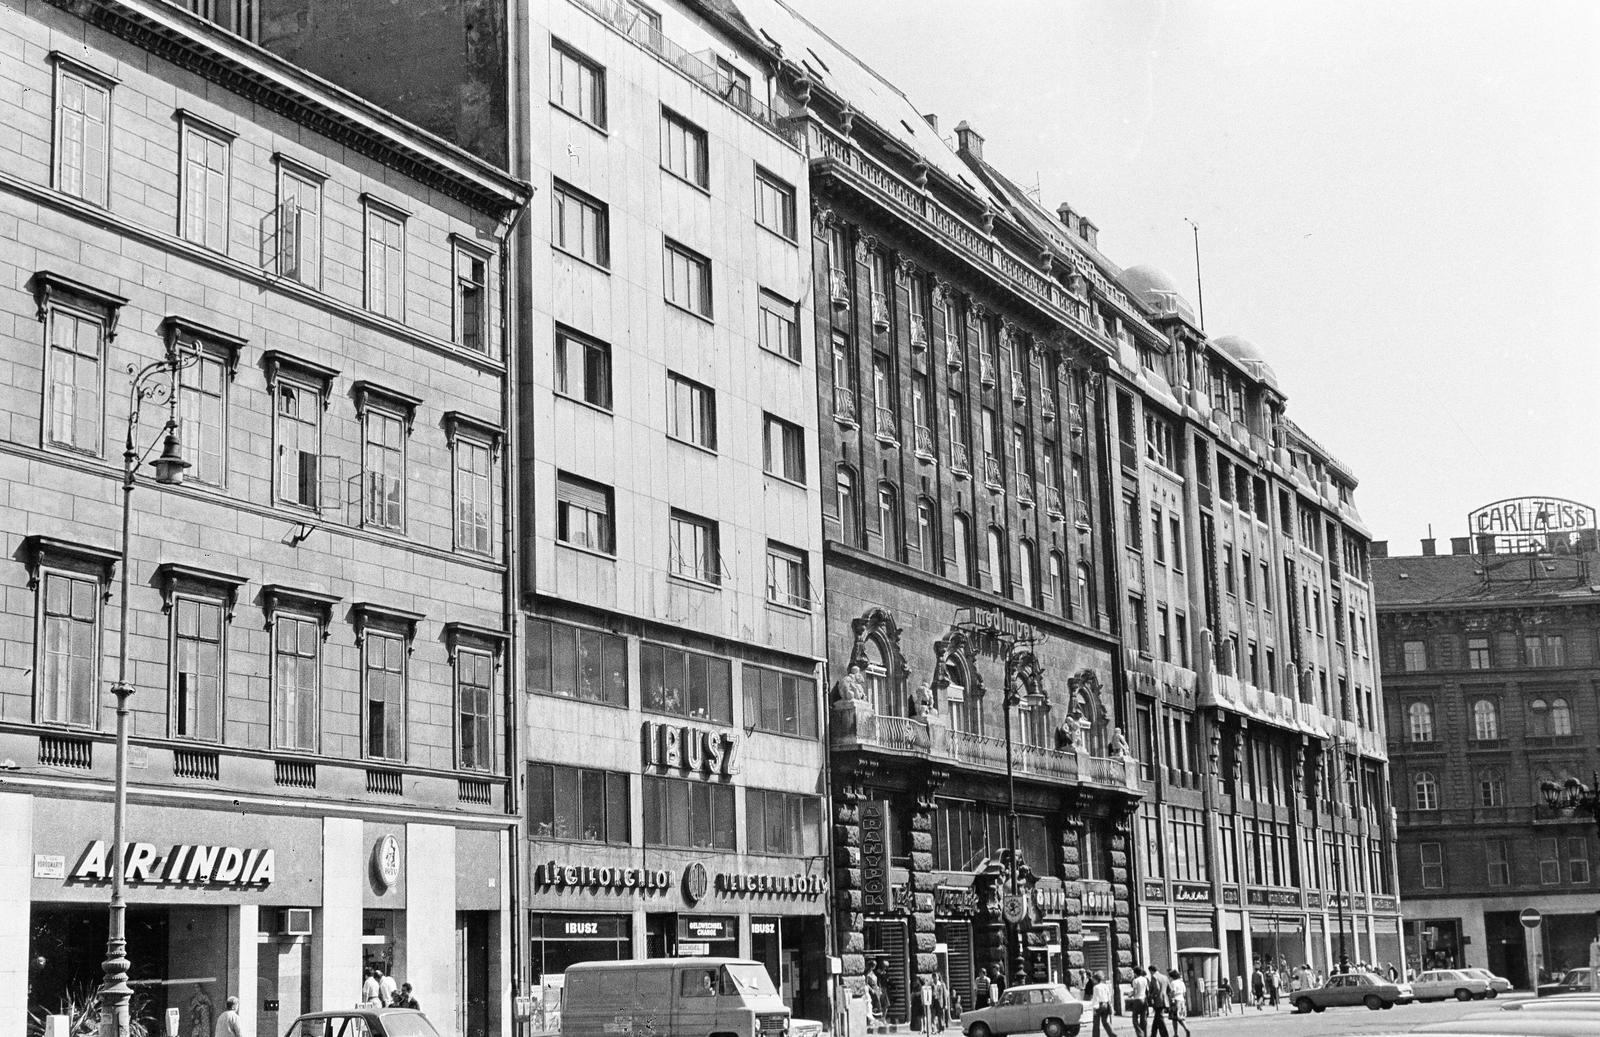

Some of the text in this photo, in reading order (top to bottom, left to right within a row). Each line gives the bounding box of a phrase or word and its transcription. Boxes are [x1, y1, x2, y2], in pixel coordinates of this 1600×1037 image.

[1477, 501, 1586, 532] CARL ZEISS
[648, 721, 741, 774] IBUSZ
[565, 922, 598, 934] IBUSZ
[751, 923, 775, 934] IBUSZ
